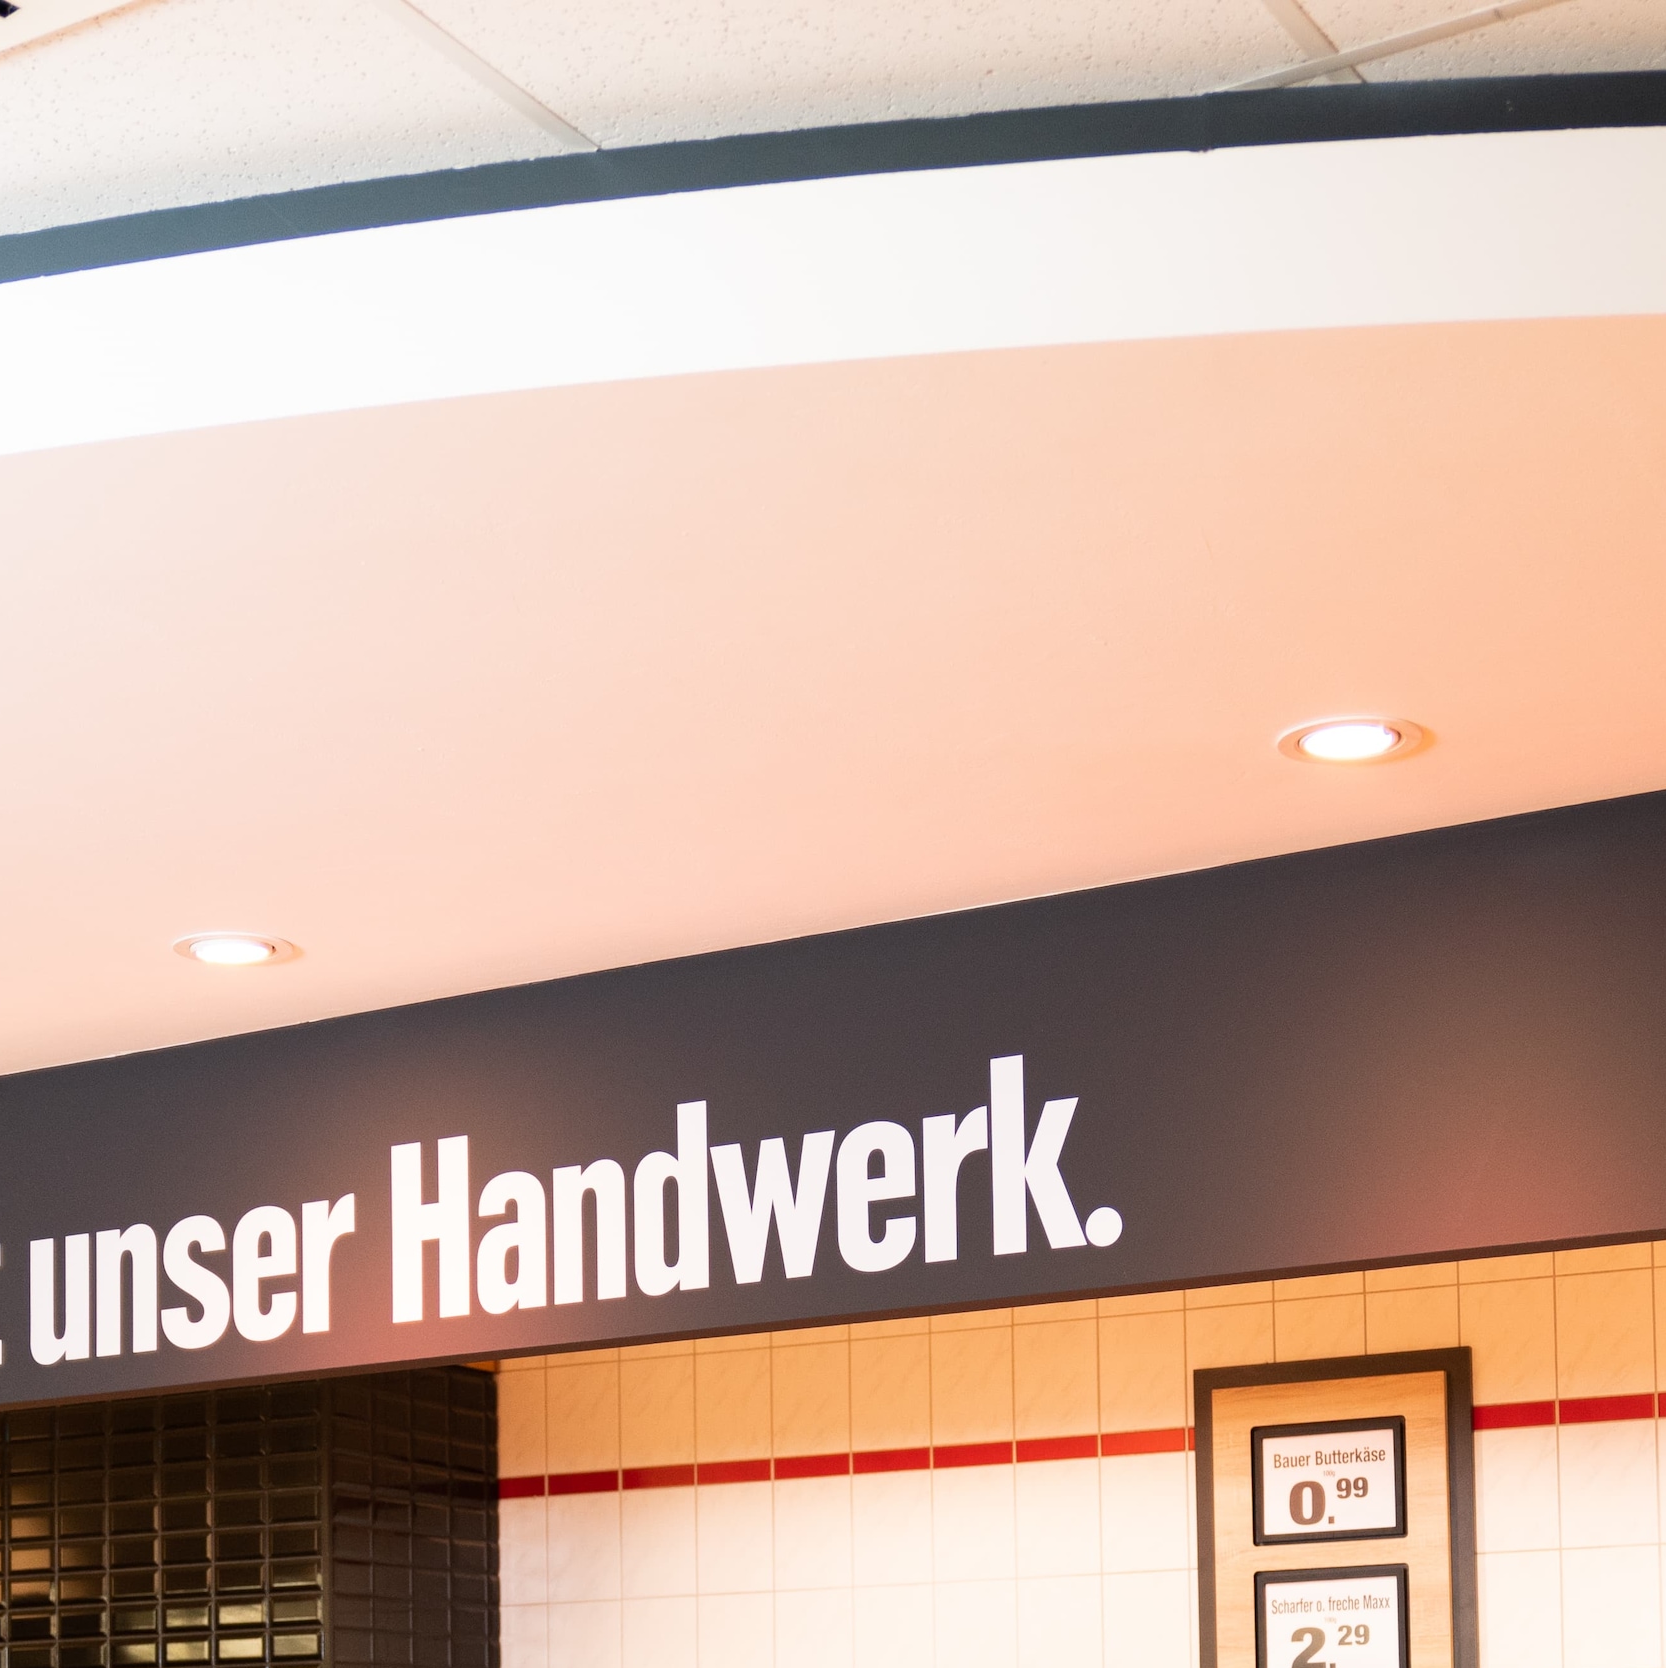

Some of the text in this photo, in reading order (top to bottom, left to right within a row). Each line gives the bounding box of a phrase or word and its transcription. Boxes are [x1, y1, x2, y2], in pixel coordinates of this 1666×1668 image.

[30, 1187, 356, 1365] unser
[390, 1054, 1124, 1324] Handwerk.
[1273, 1446, 1386, 1469] Bauer Butterkäse
[1328, 1596, 1360, 1611] freche
[1363, 1594, 1390, 1609] Maxx
